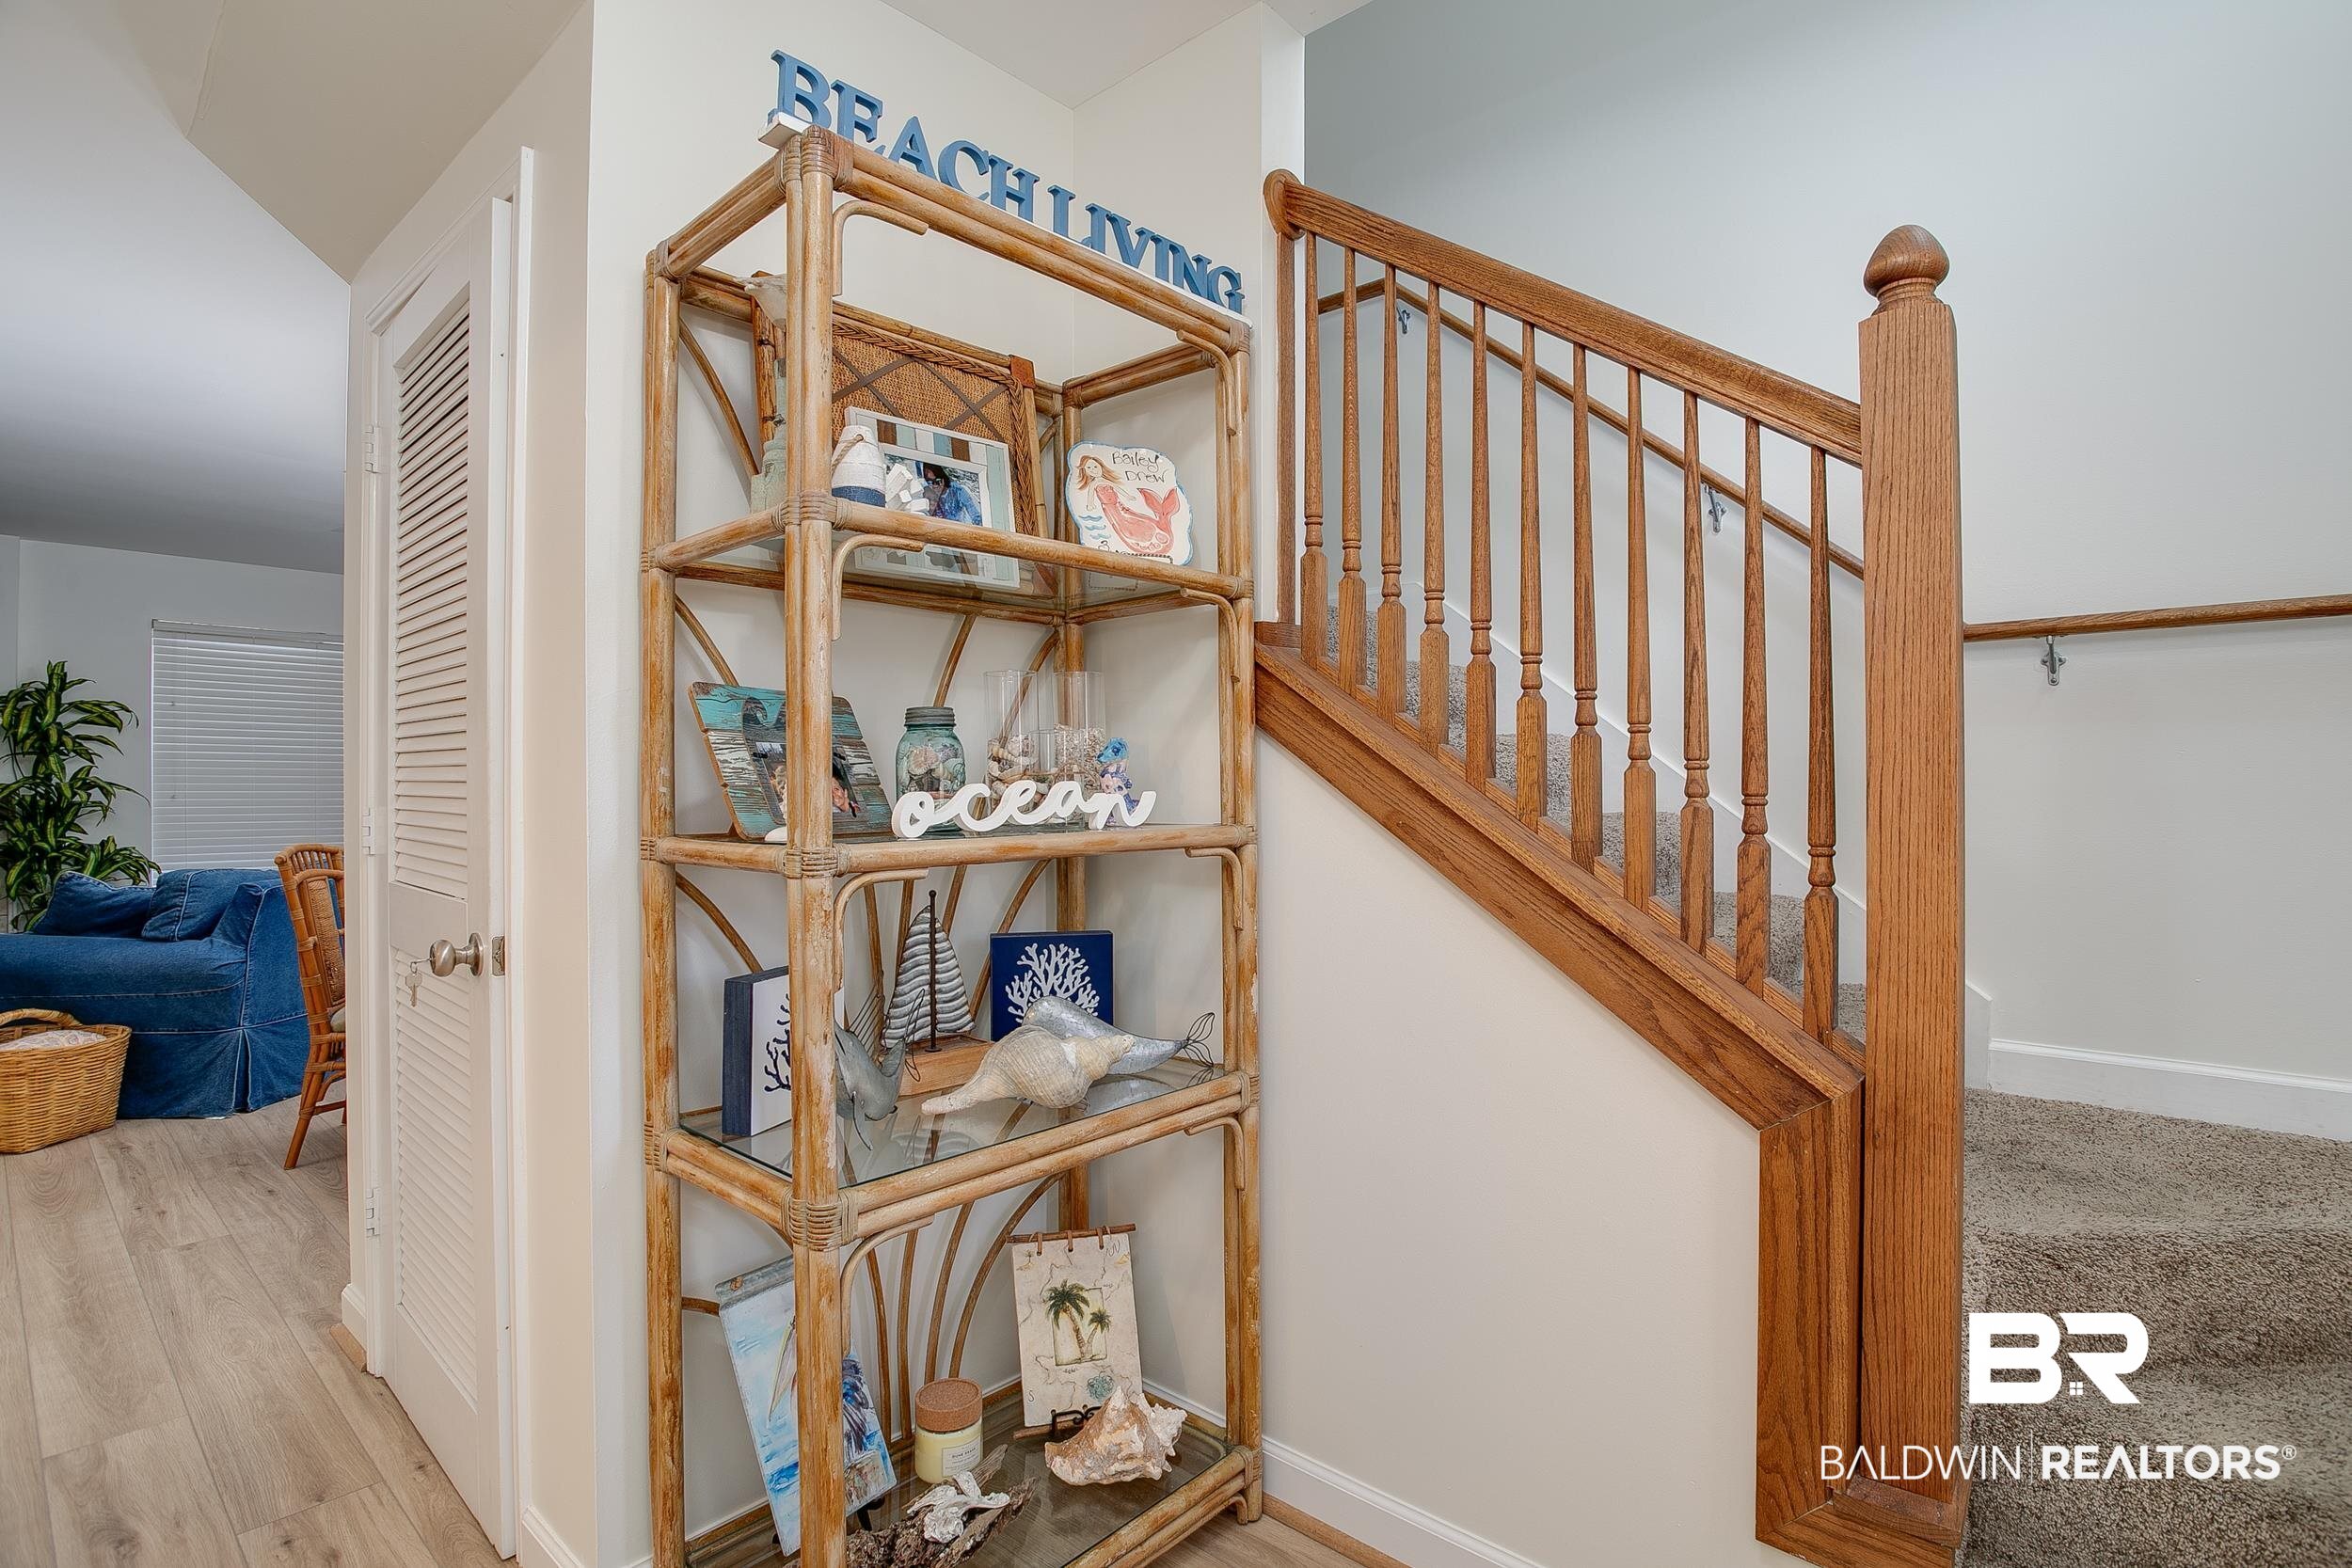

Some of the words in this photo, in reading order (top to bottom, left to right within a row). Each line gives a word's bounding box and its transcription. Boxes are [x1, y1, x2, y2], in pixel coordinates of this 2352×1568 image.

[767, 49, 1041, 224] BEACH
[1047, 184, 1246, 315] LIVING
[1112, 451, 1160, 473] Bailey
[1125, 469, 1169, 483] Drew
[892, 780, 1157, 838] ocean
